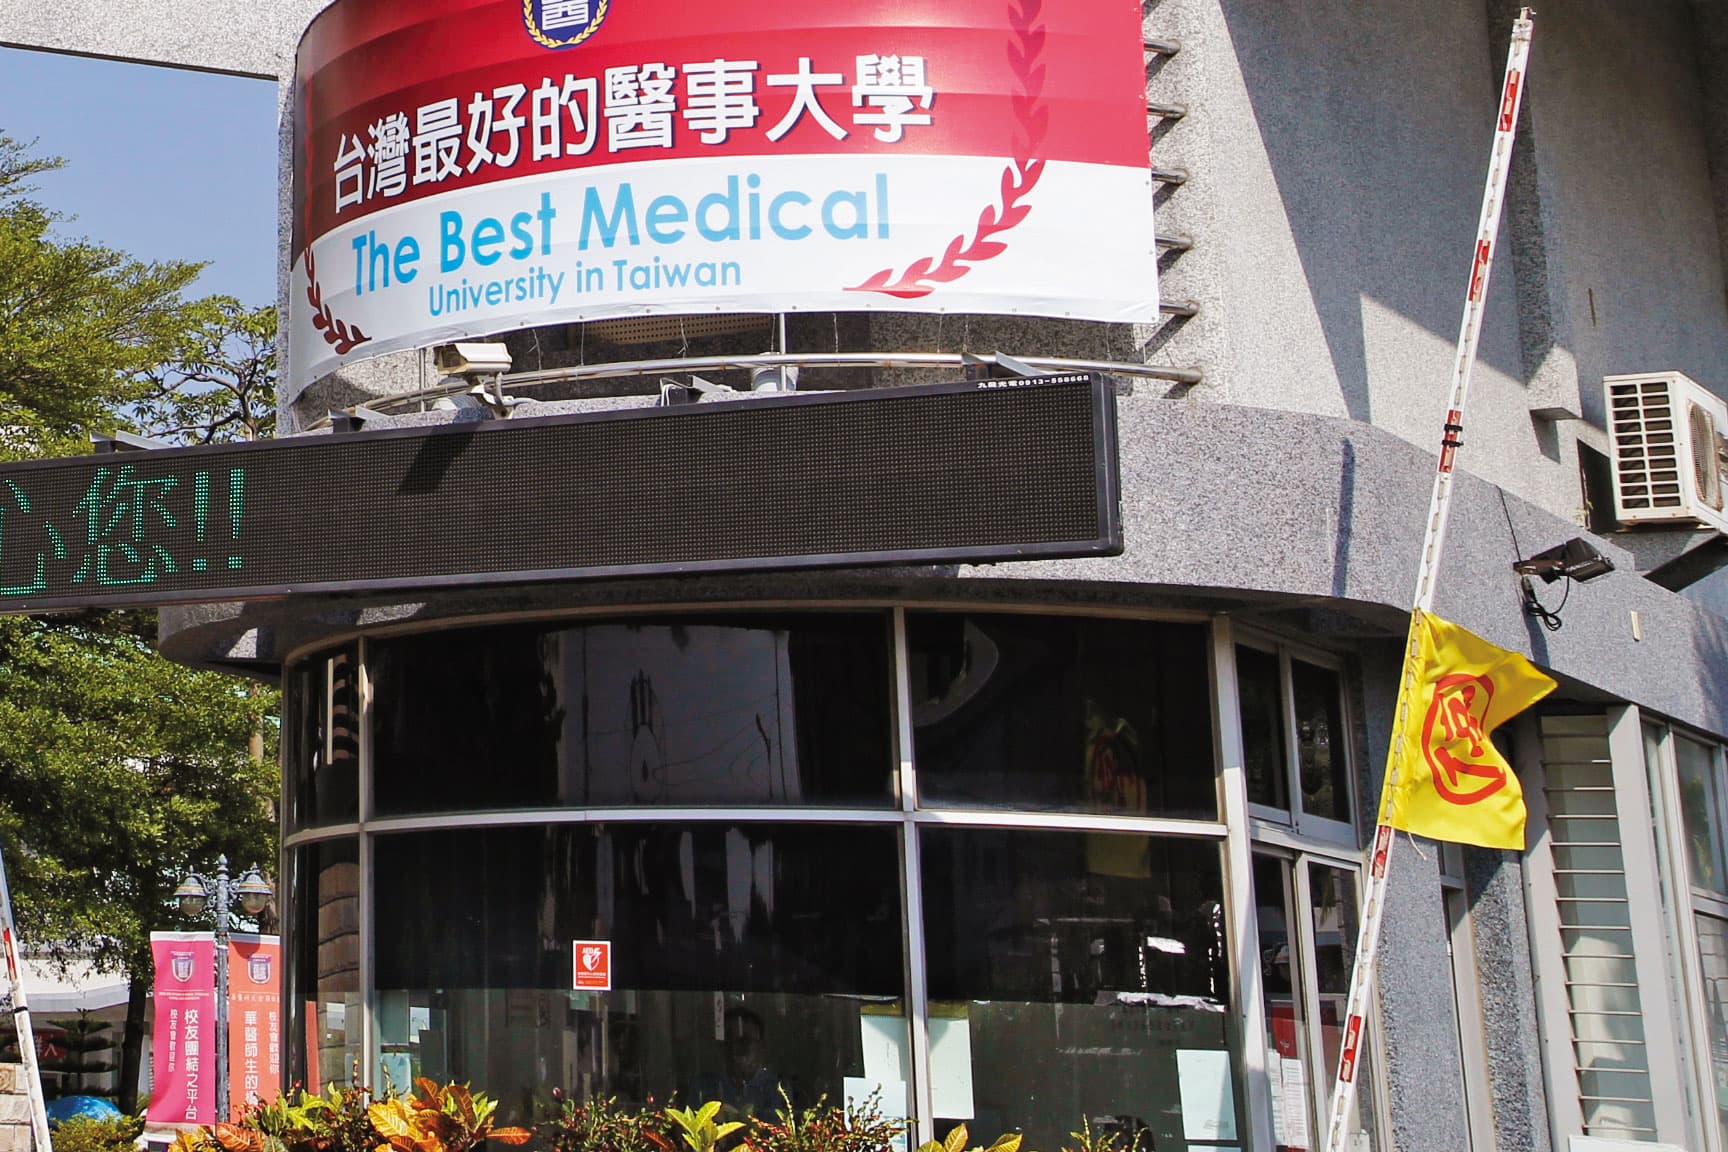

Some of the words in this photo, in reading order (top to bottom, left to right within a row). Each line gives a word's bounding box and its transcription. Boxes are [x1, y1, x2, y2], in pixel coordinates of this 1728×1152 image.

[332, 54, 936, 216] 台灣最好的醫事大學
[352, 229, 421, 296] The
[440, 191, 557, 274] Best
[578, 173, 890, 251] Medical
[429, 266, 565, 318] University
[576, 266, 604, 293] in
[612, 258, 741, 291] Taiwan
[184, 1009, 200, 1121] 校友團結之平台
